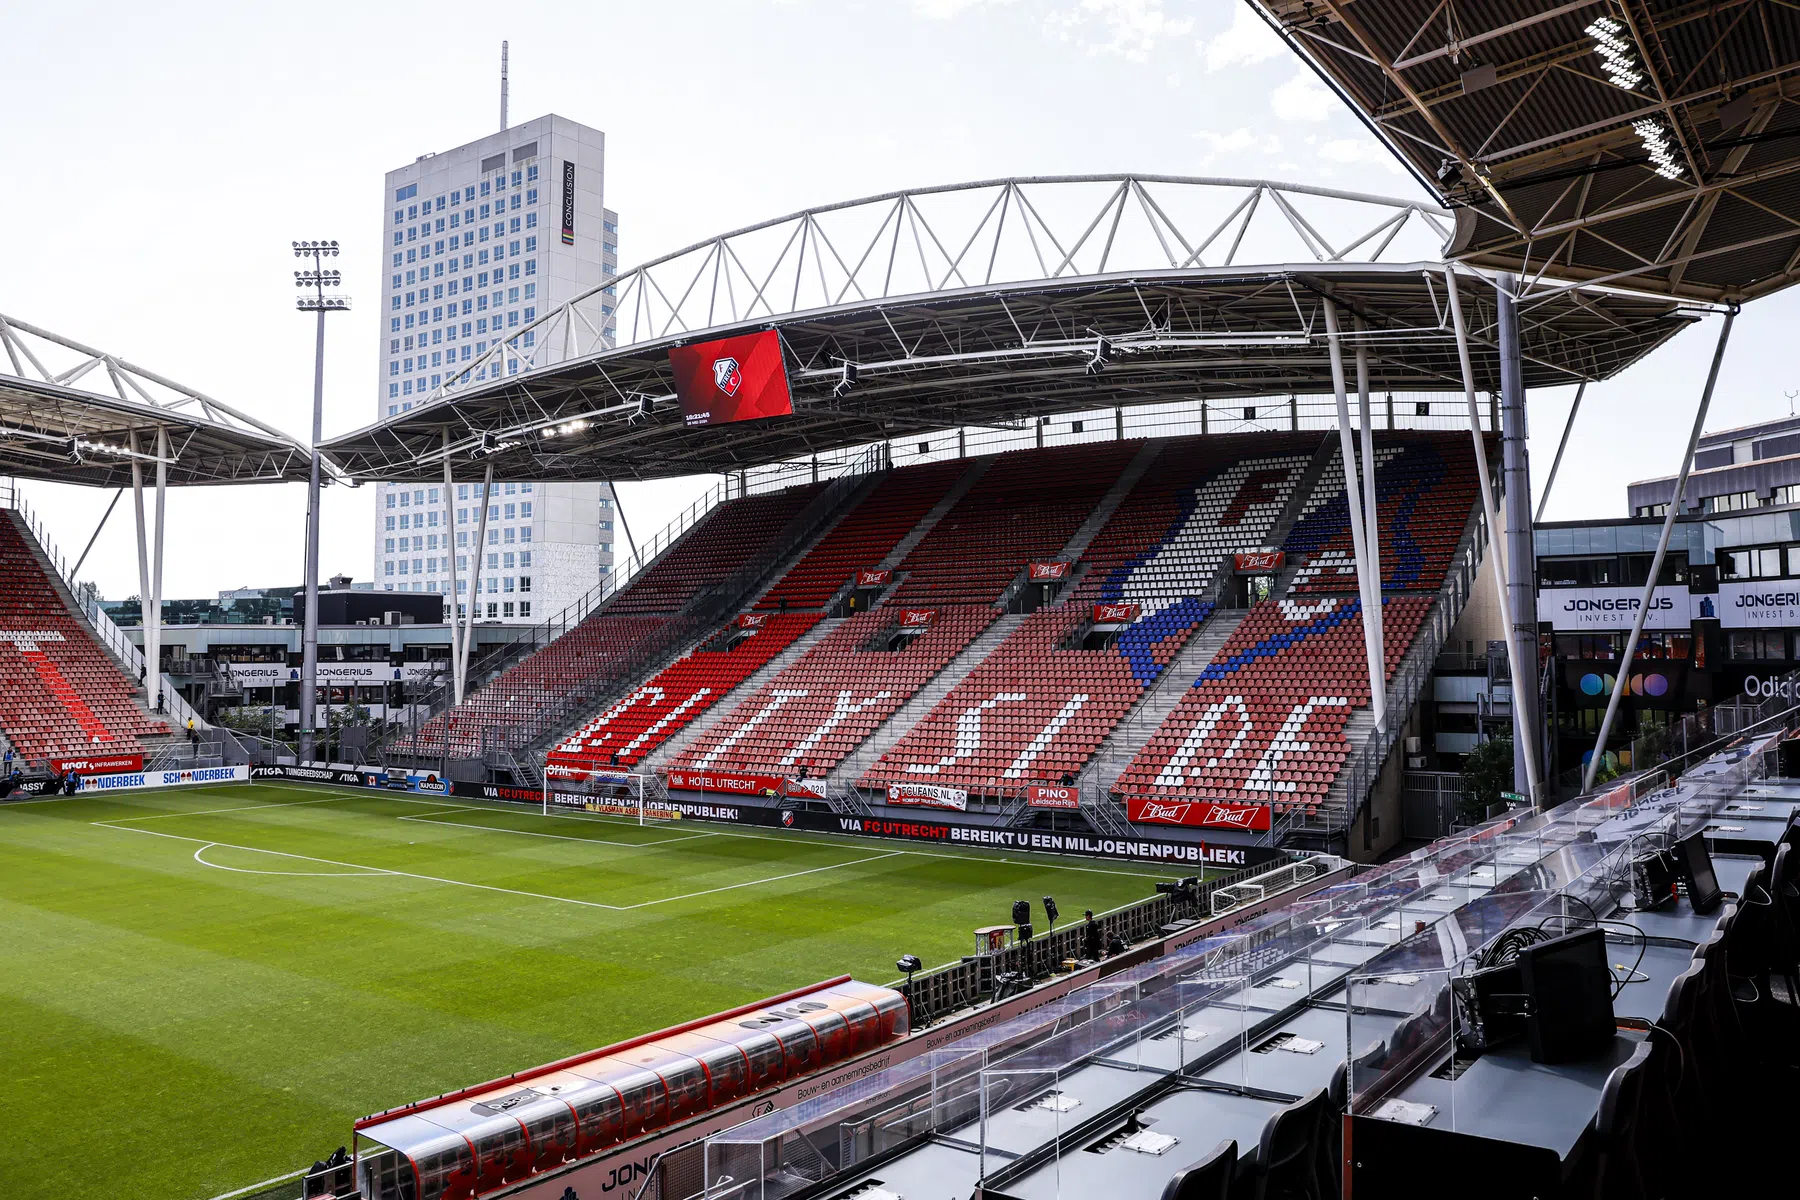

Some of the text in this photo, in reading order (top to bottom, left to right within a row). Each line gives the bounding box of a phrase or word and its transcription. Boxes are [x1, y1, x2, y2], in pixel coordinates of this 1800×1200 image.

[565, 165, 573, 227] CONCLUSION
[720, 361, 737, 388] UTRECHT
[1564, 598, 1673, 612] JONGERUS
[1580, 614, 1624, 622] INVEST
[1748, 610, 1783, 619] INVEST
[316, 668, 373, 676] JONGERIUS
[62, 760, 133, 770] KOOT INFRAWERKEN
[251, 767, 359, 782] STIGA TUINGEREEDSCHAP STIGA
[420, 783, 444, 791] NAPOLEON
[688, 777, 714, 788] HOTEL
[717, 778, 756, 790] UTRECHT
[810, 785, 824, 794] 020
[484, 786, 498, 798] VIA
[499, 788, 510, 798] FC
[512, 789, 554, 802] UTRECT
[554, 793, 595, 804] BEREIKT
[901, 786, 952, 800] FCUFANS.NL
[1038, 788, 1068, 798] PINO
[1031, 797, 1076, 808] Leidsche Rijn
[1147, 804, 1244, 822] Bud Bud
[840, 818, 1246, 864] VIA FC UTRECHT BEREIKT U EEN MILJOENENPUBLIEK!
[926, 1032, 944, 1049] Bouw-
[798, 1055, 891, 1100] Bouw- en aannemingsbedrijf
